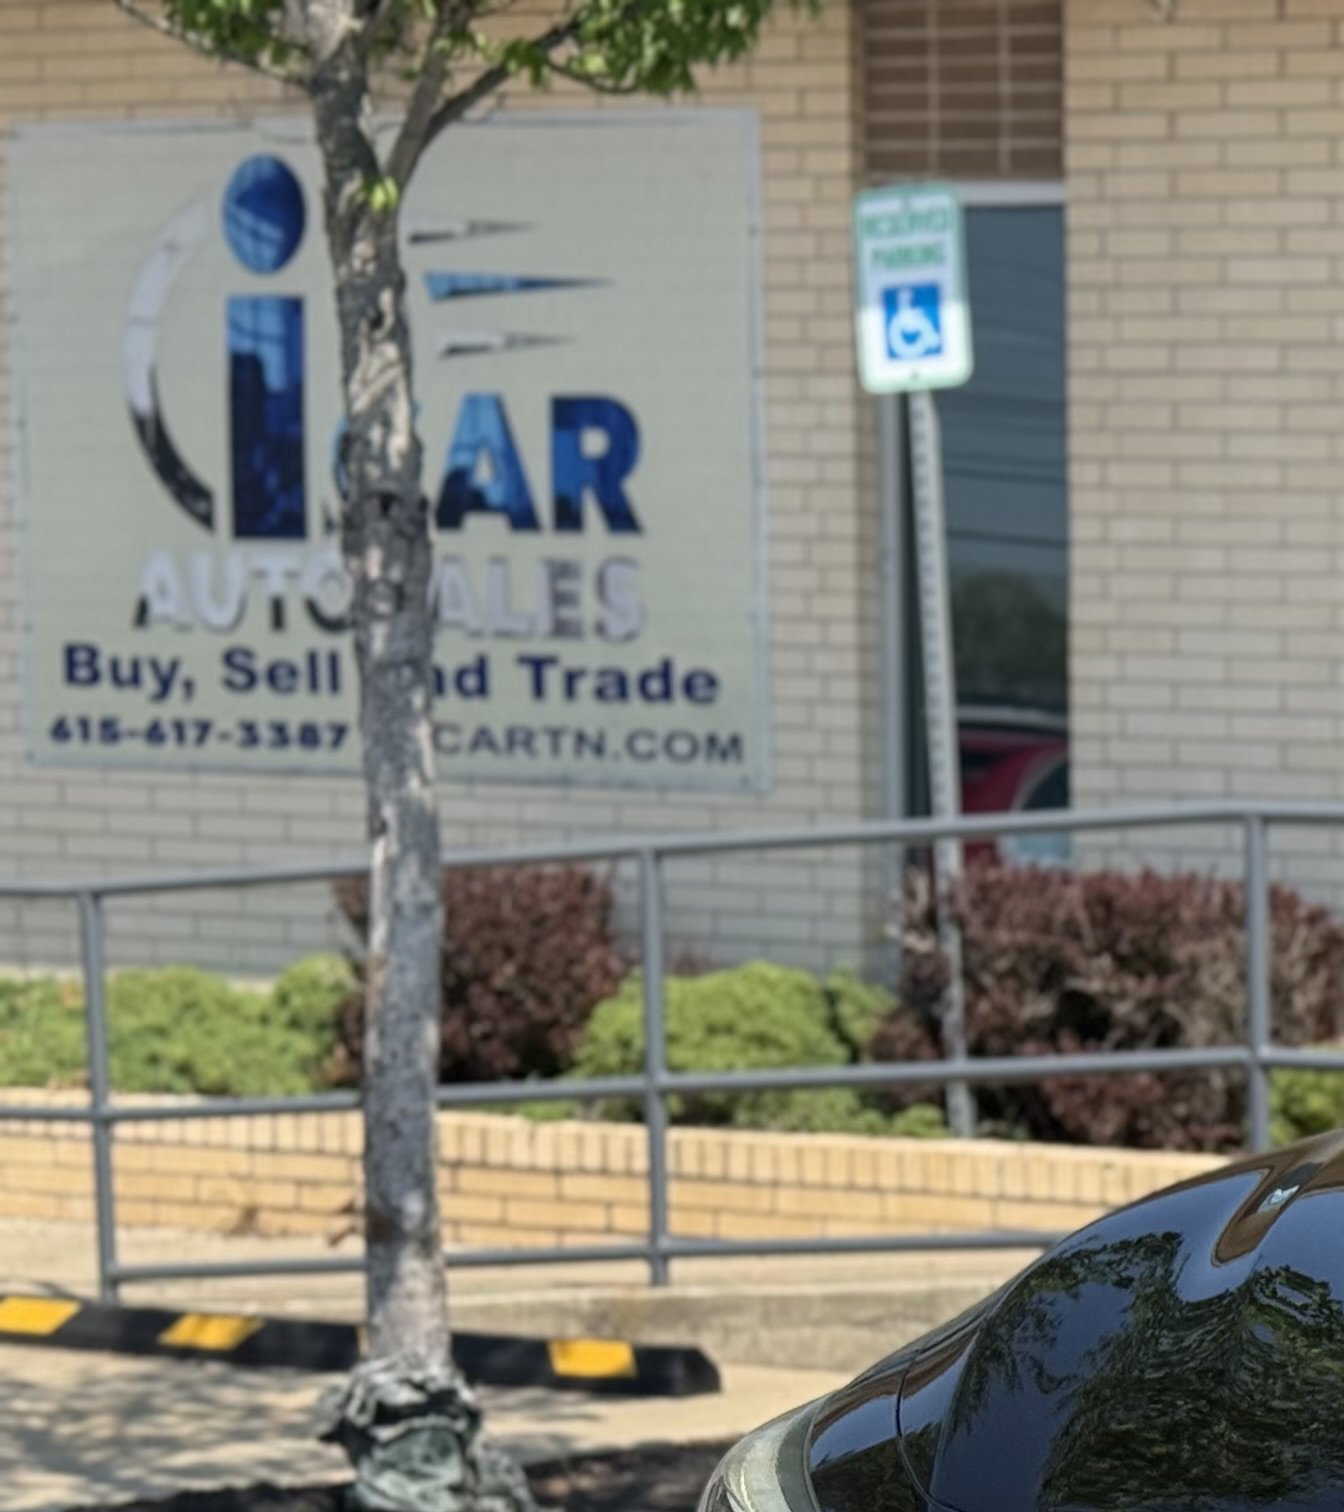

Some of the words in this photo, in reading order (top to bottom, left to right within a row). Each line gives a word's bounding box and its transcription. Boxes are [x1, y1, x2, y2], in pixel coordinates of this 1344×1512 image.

[133, 547, 646, 643] AUTOALES
[63, 643, 196, 702] Buy,
[221, 646, 341, 694] Sell
[516, 655, 721, 706] Trade
[50, 715, 349, 750] 615-617-3387
[434, 721, 746, 766] CARTN.COM
